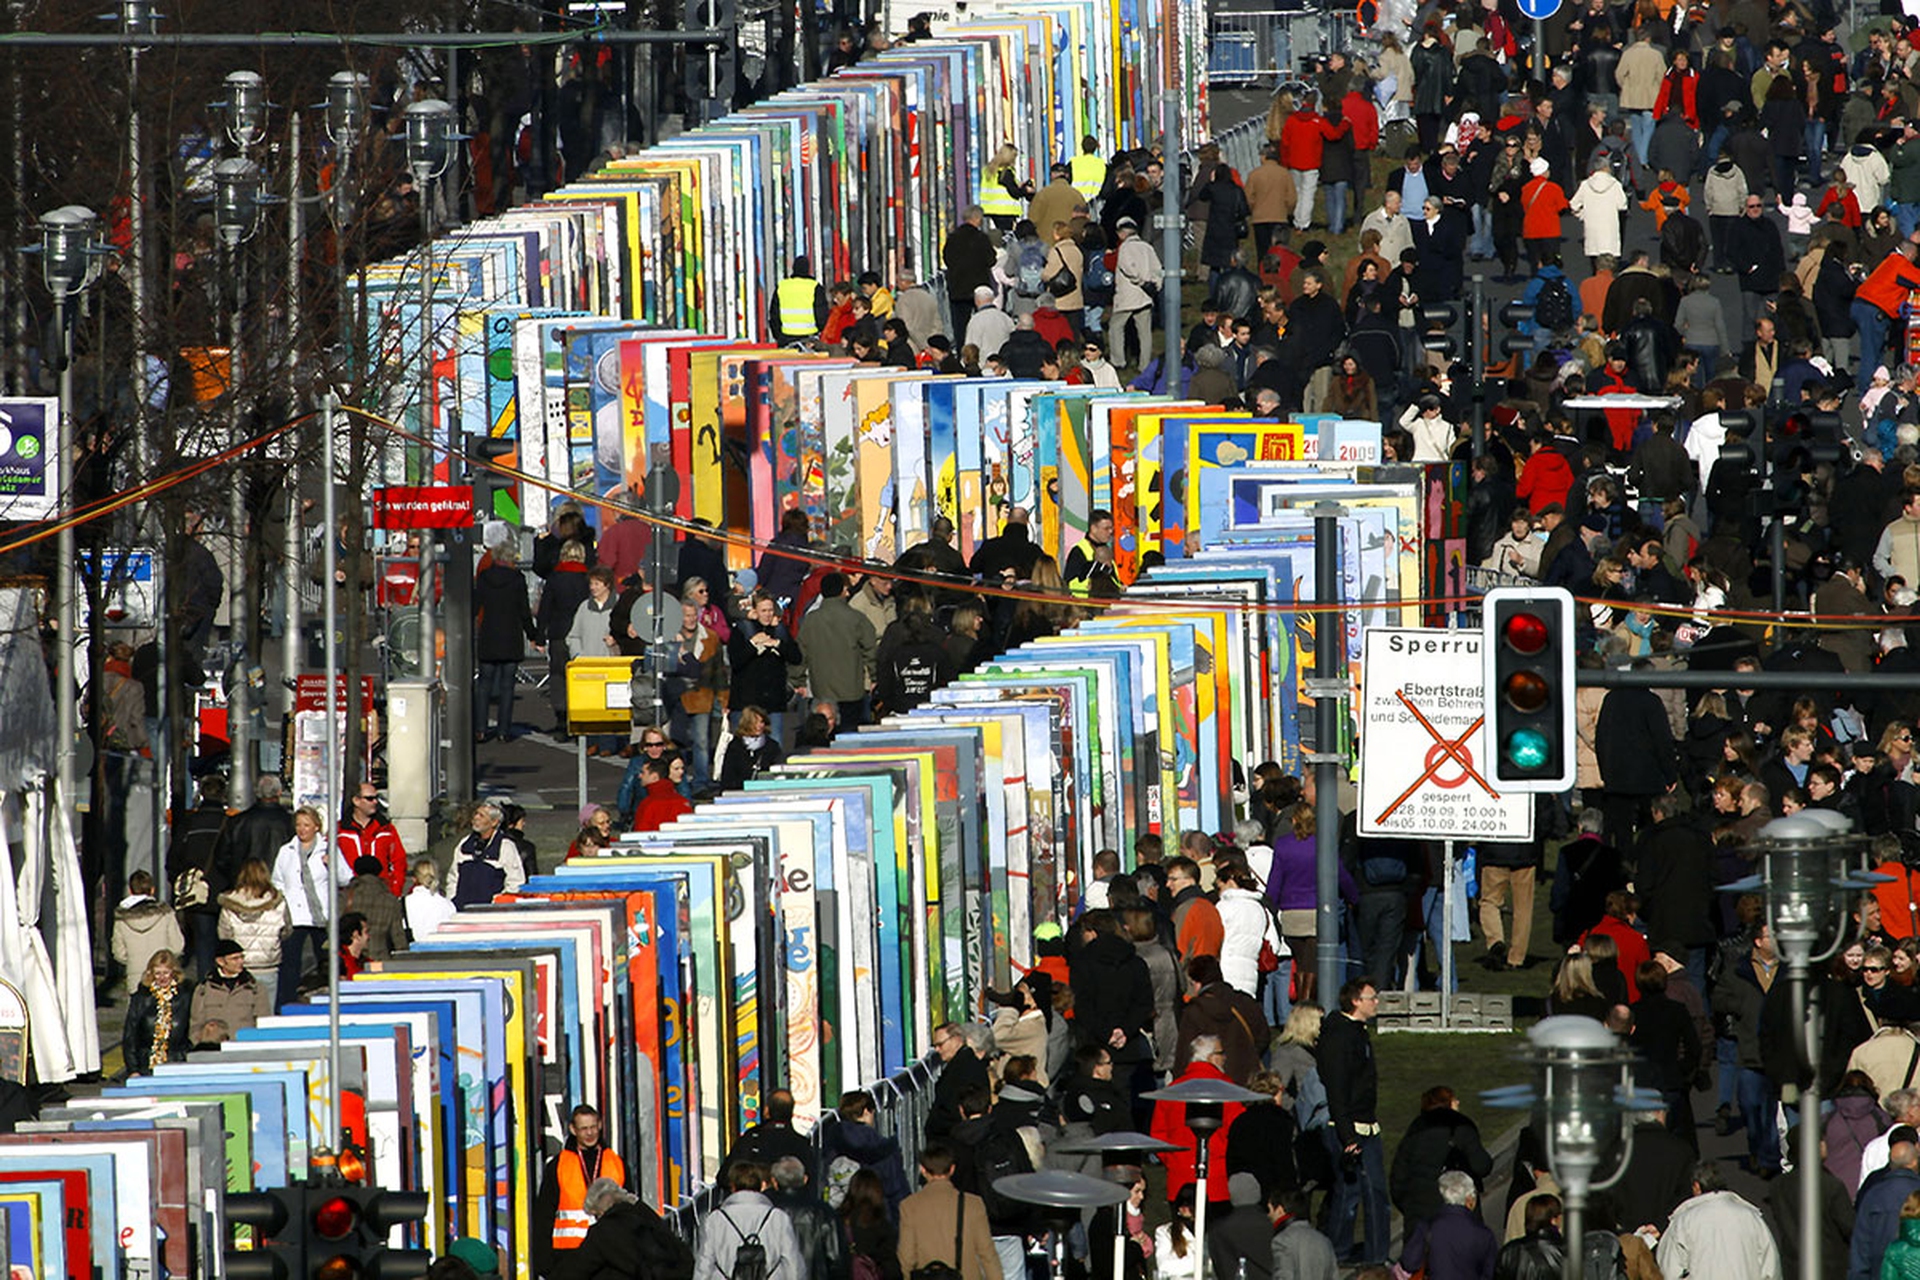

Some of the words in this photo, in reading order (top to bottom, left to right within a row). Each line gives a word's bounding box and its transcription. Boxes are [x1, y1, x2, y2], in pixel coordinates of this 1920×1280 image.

[1339, 445, 1376, 462] 2009
[1370, 712, 1395, 722] und
[1421, 792, 1471, 804] gesperrt
